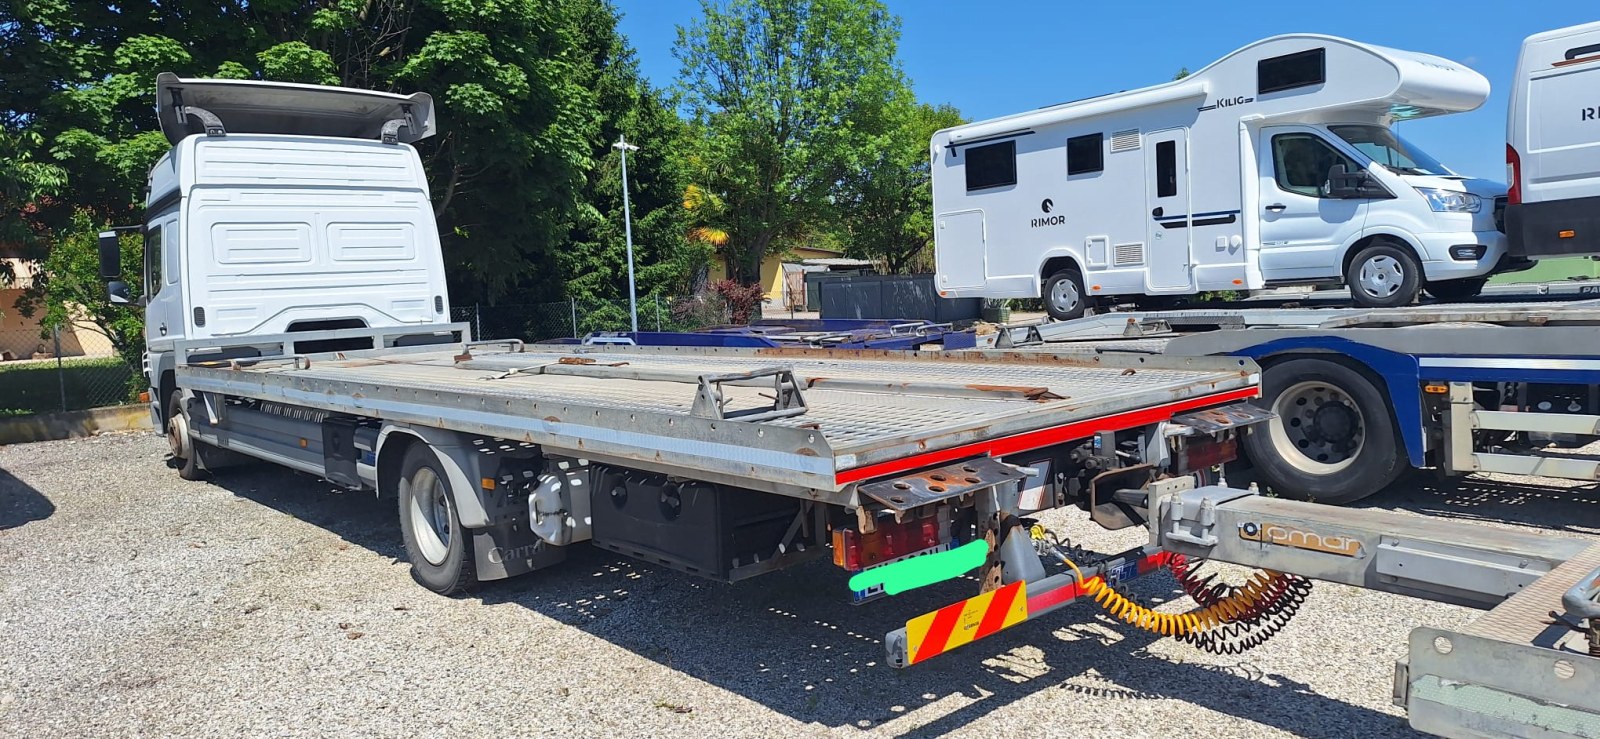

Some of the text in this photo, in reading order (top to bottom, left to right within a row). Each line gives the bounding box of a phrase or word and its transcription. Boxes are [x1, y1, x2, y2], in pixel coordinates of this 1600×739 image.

[1216, 96, 1244, 109] KILIG
[1031, 215, 1066, 228] RIMOR
[1582, 286, 1600, 294] PA
